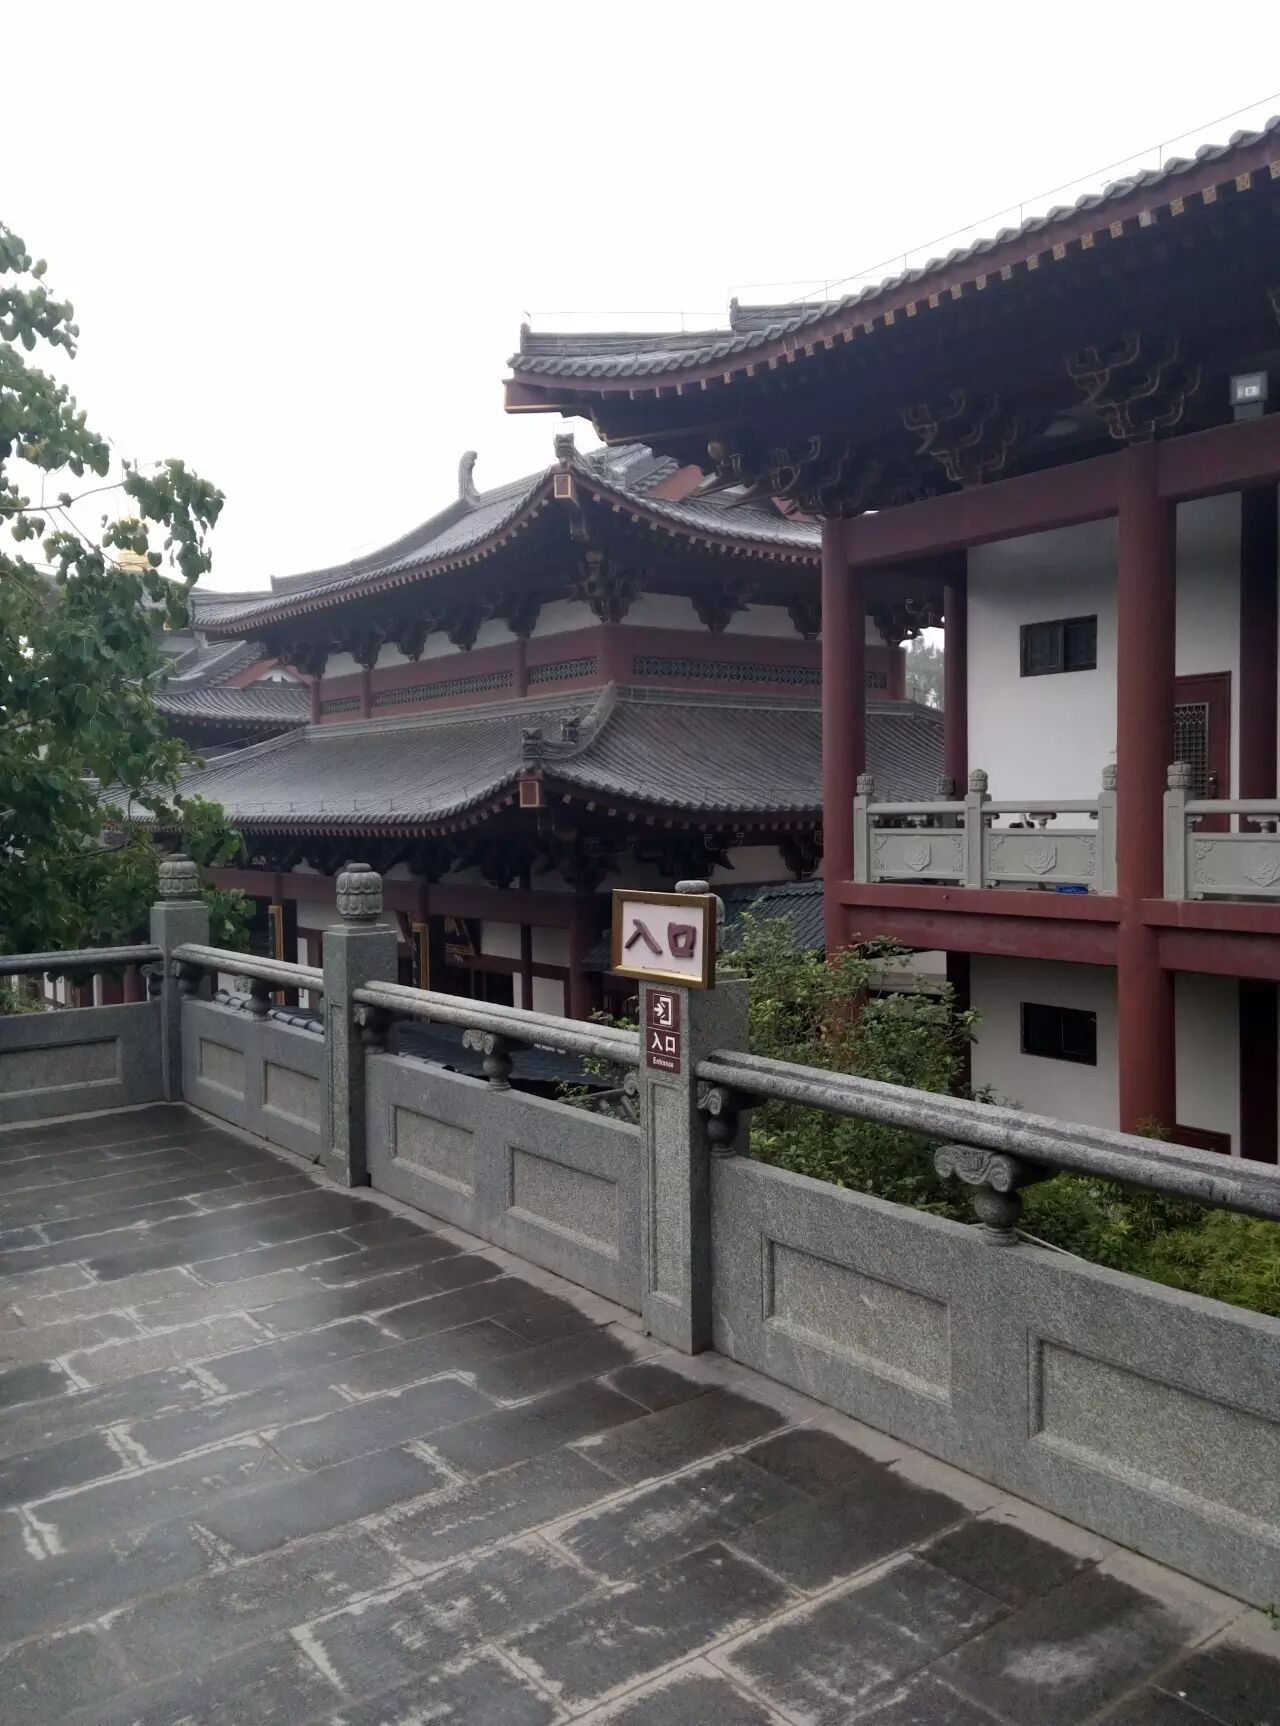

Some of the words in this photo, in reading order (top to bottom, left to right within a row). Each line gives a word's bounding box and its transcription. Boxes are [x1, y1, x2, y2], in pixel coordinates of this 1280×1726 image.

[625, 919, 696, 958] 入口
[652, 1032, 675, 1053] 入口
[653, 1056, 674, 1068] Entrance
